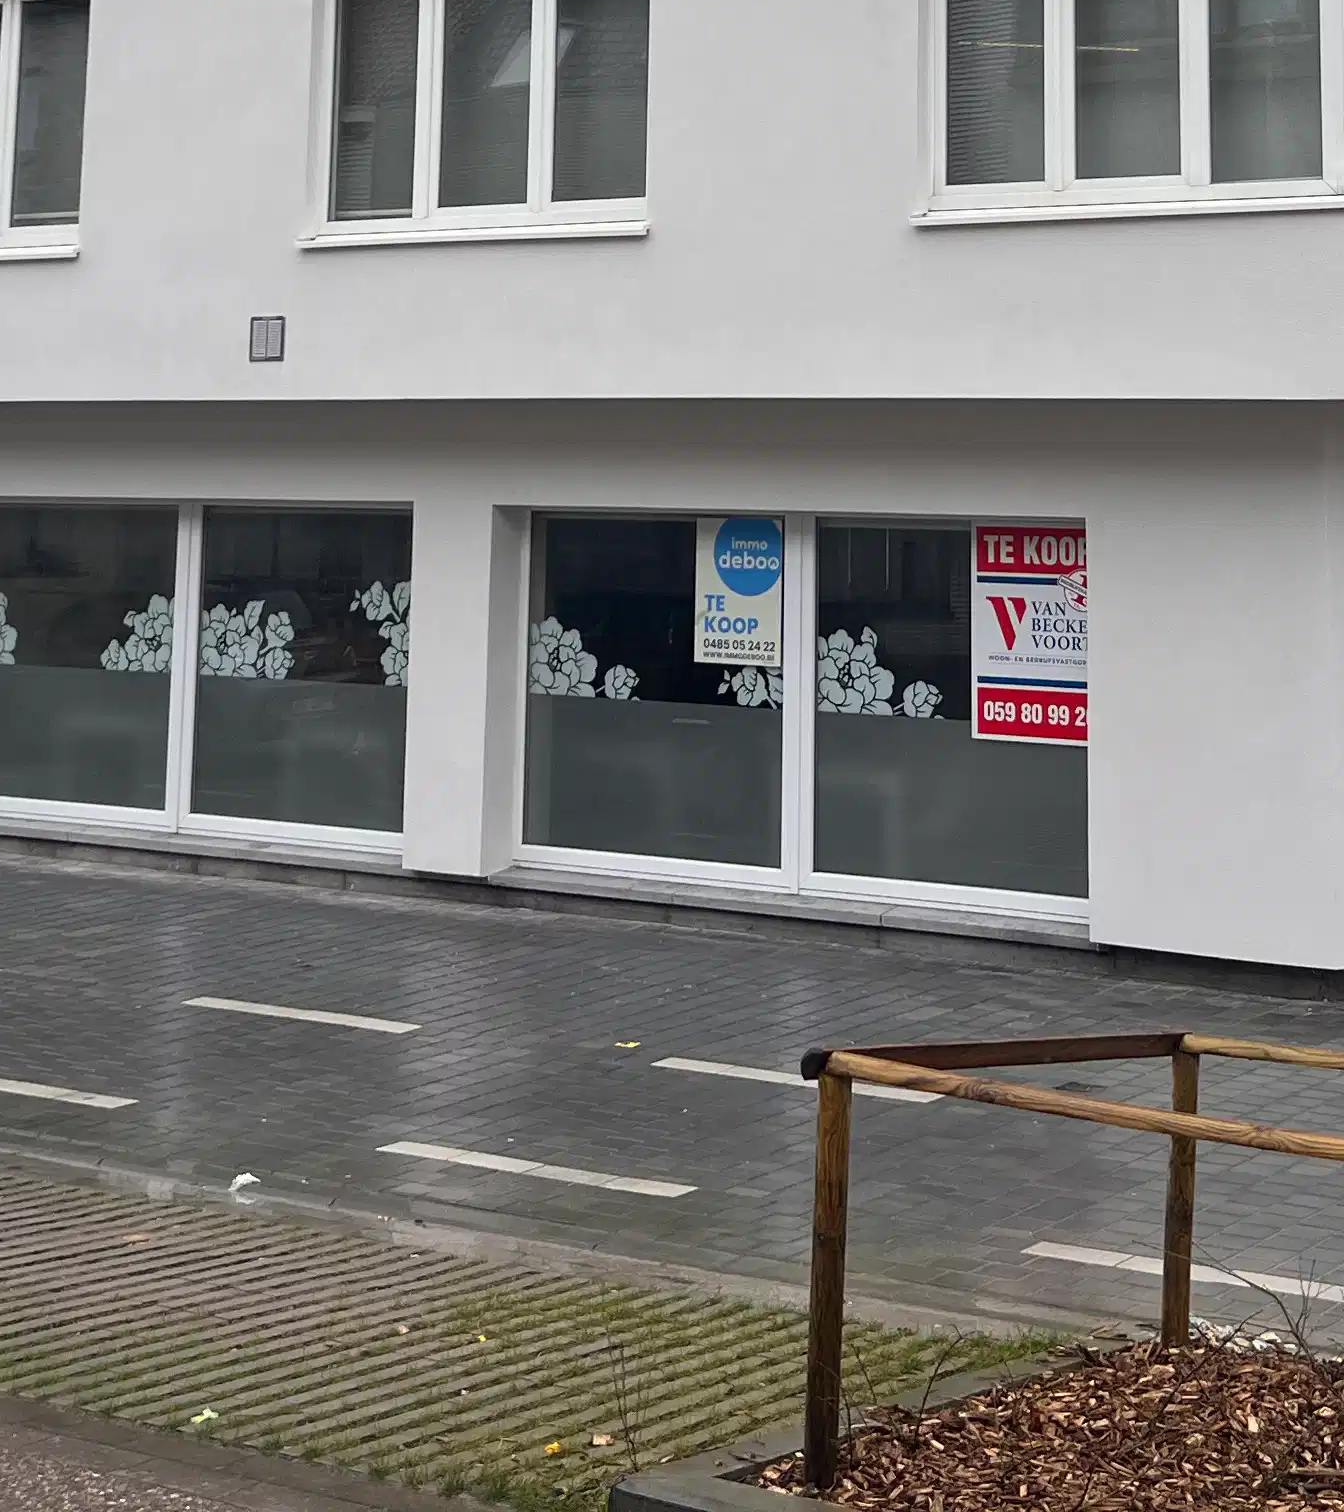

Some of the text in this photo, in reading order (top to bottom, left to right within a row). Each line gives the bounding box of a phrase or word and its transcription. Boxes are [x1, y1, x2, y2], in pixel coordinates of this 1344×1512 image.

[731, 537, 768, 551] immo
[983, 534, 1015, 564] TE
[718, 550, 780, 570] deboo
[704, 594, 726, 612] TE
[1031, 600, 1067, 617] VAN
[704, 616, 759, 635] KOOP
[703, 638, 776, 653] 0485 05 24 22
[983, 700, 1088, 727] 059 80 99 2
